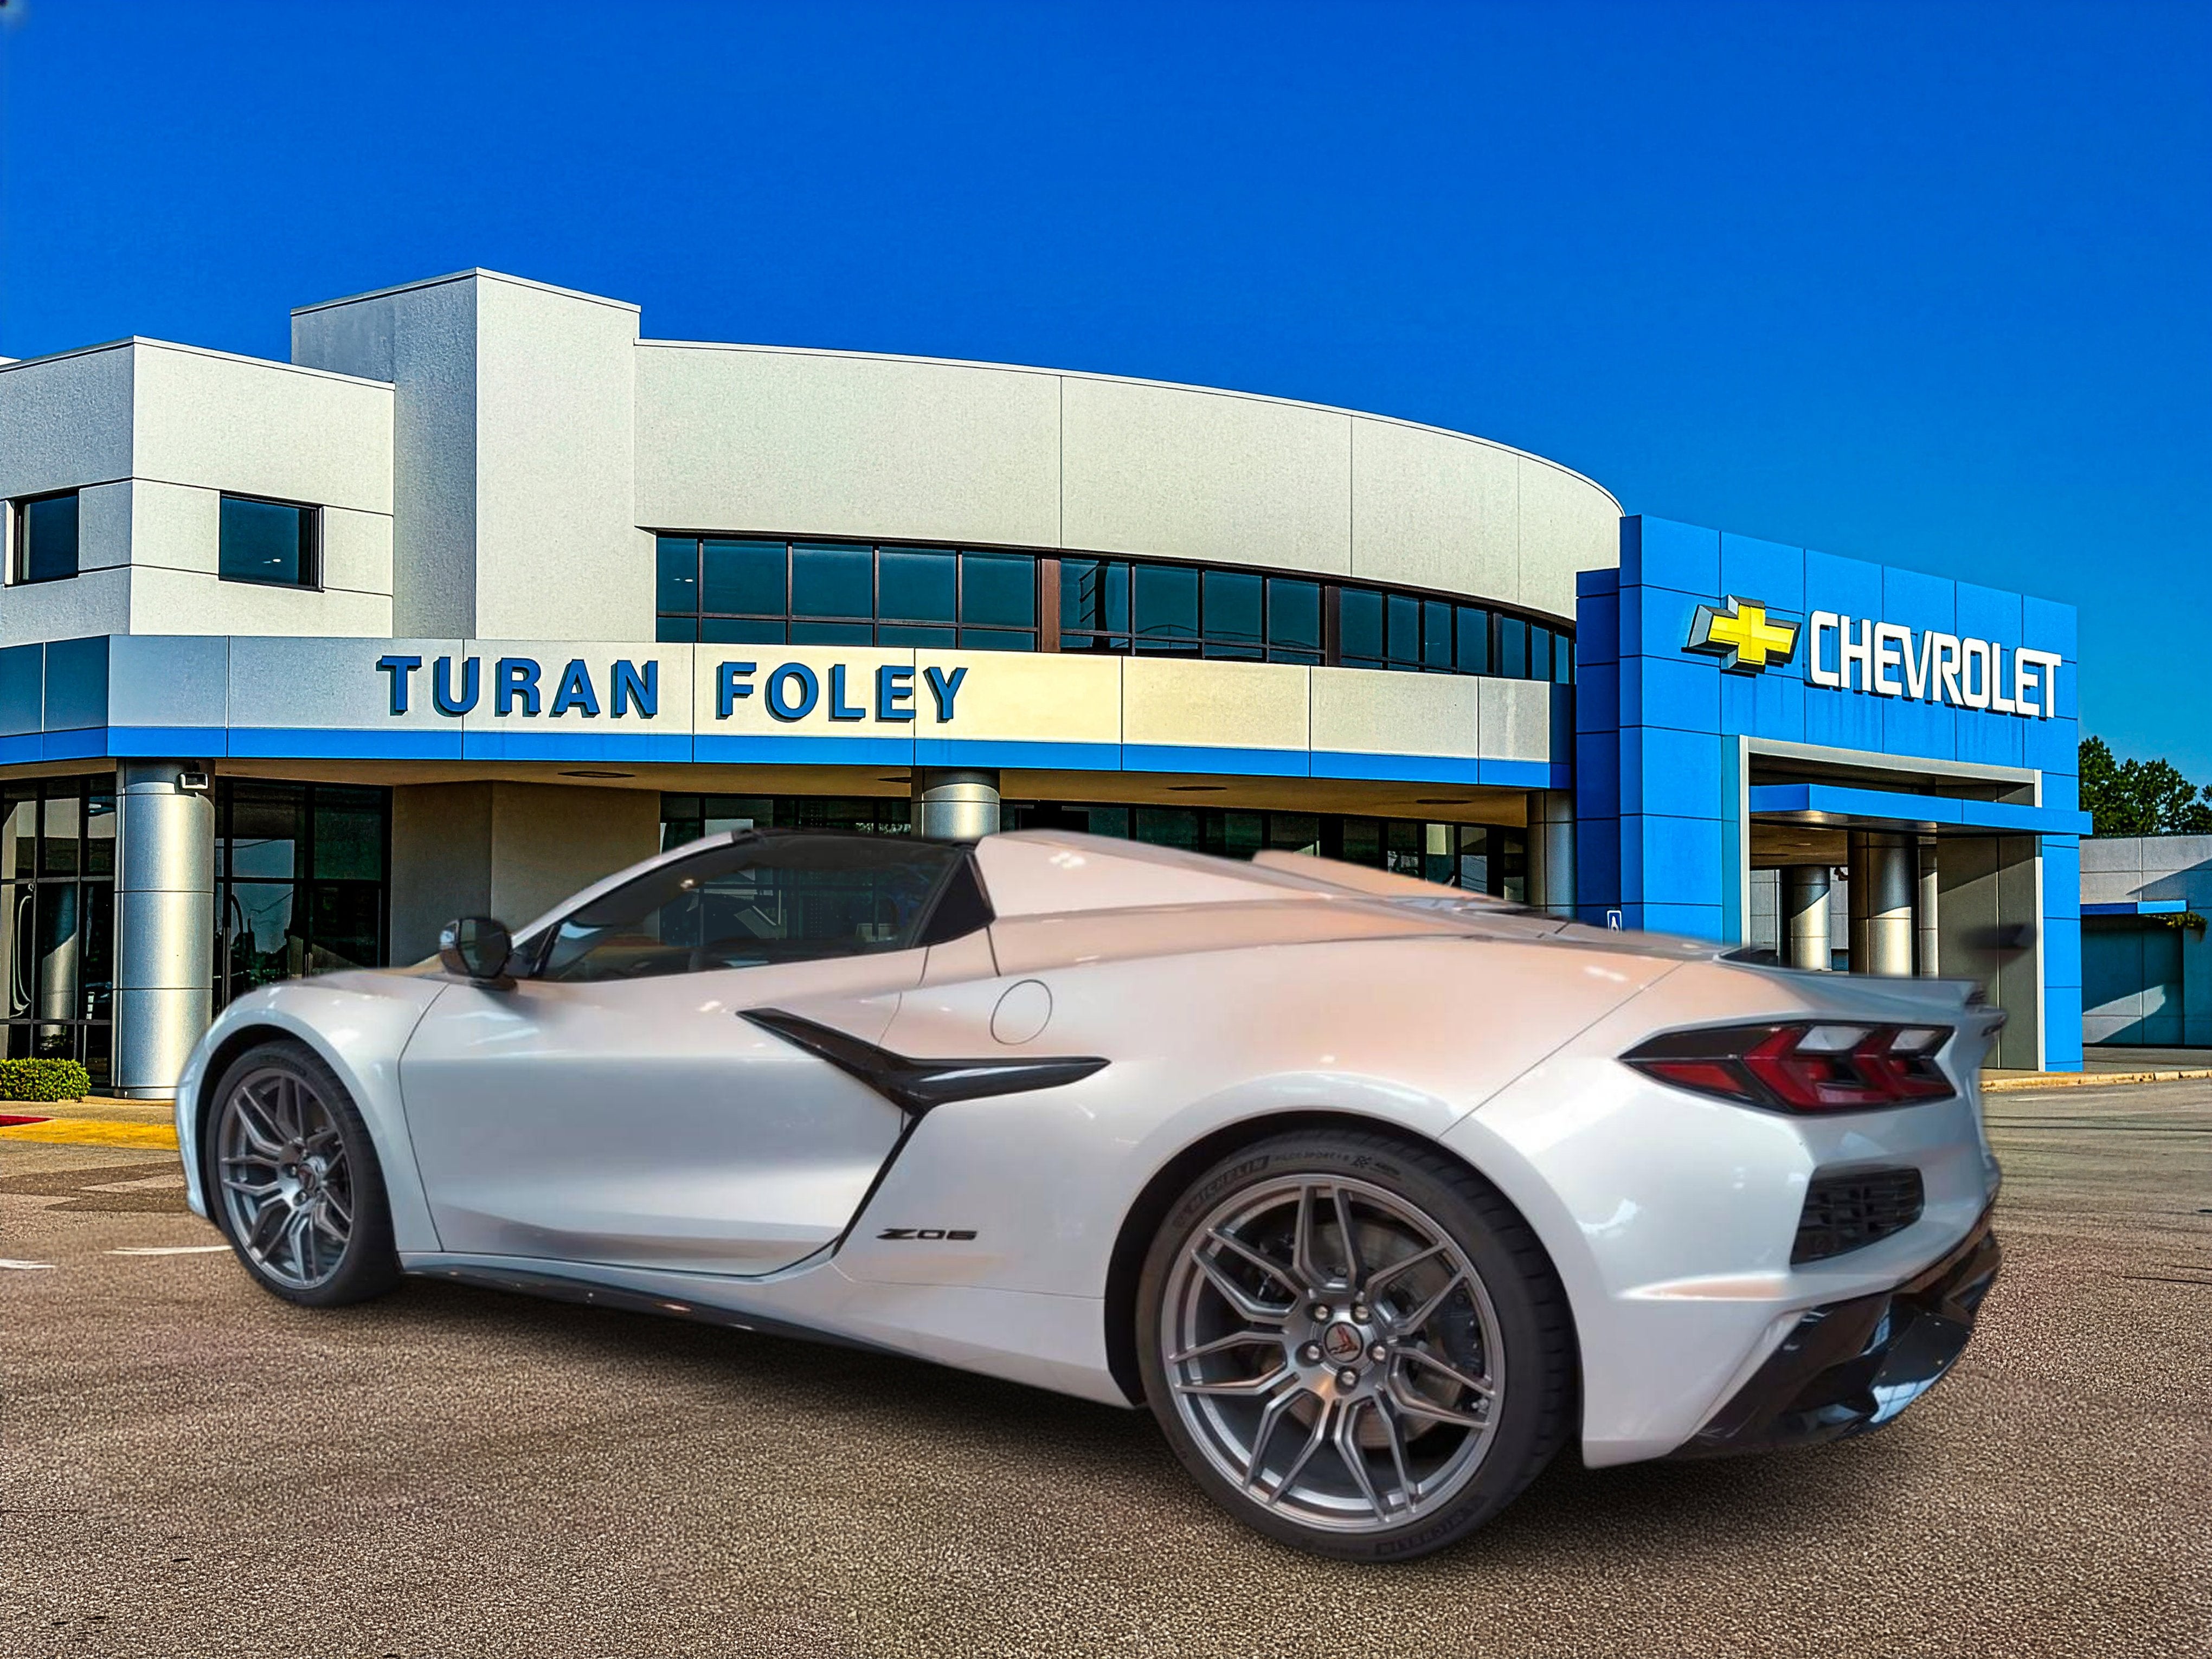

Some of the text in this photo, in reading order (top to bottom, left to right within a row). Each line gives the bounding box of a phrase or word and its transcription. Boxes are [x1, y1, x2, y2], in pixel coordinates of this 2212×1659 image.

[376, 655, 968, 723] TURAN FOLEY
[1810, 610, 2062, 718] CHEVROLET
